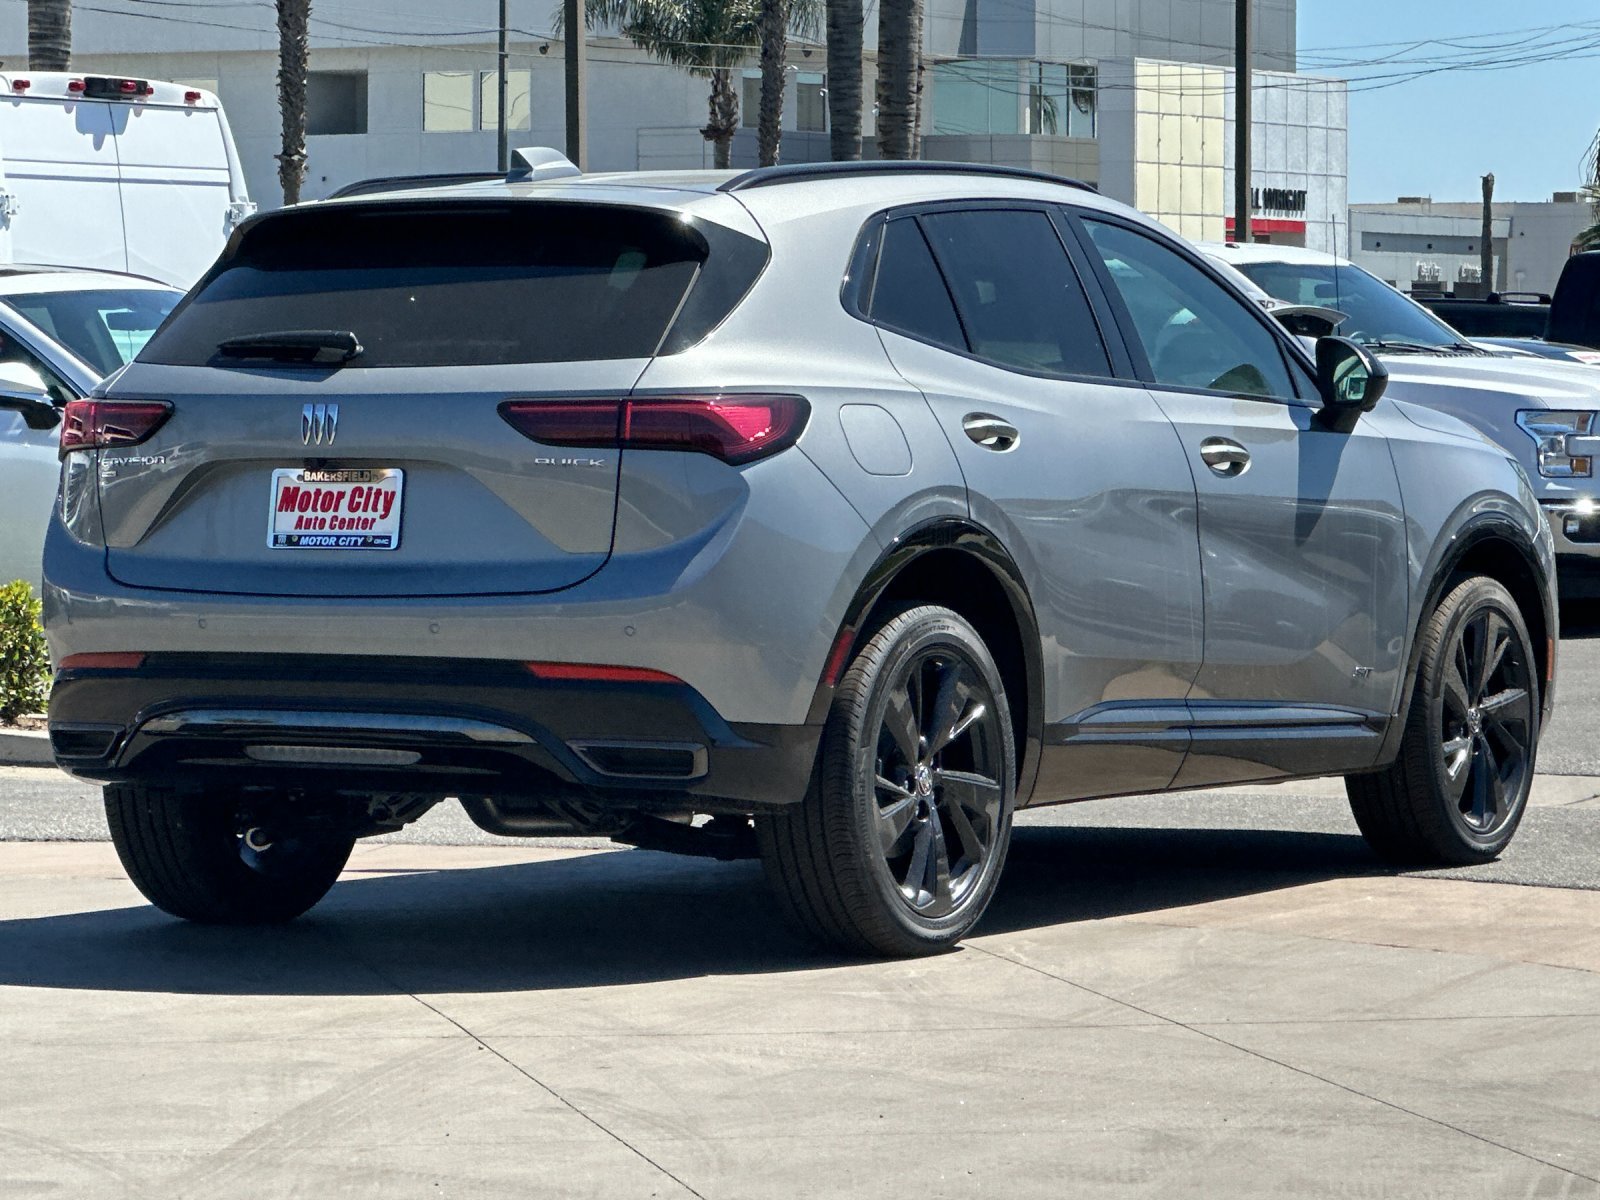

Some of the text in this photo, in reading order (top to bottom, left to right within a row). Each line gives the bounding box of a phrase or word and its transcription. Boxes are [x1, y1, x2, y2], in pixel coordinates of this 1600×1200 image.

[1262, 188, 1307, 211] WRIGHT
[304, 471, 371, 482] BAKERSFIELD
[277, 486, 396, 519] Motor City
[294, 515, 376, 531] Auto Center
[299, 536, 336, 546] MOTOR
[338, 537, 364, 546] CITY
